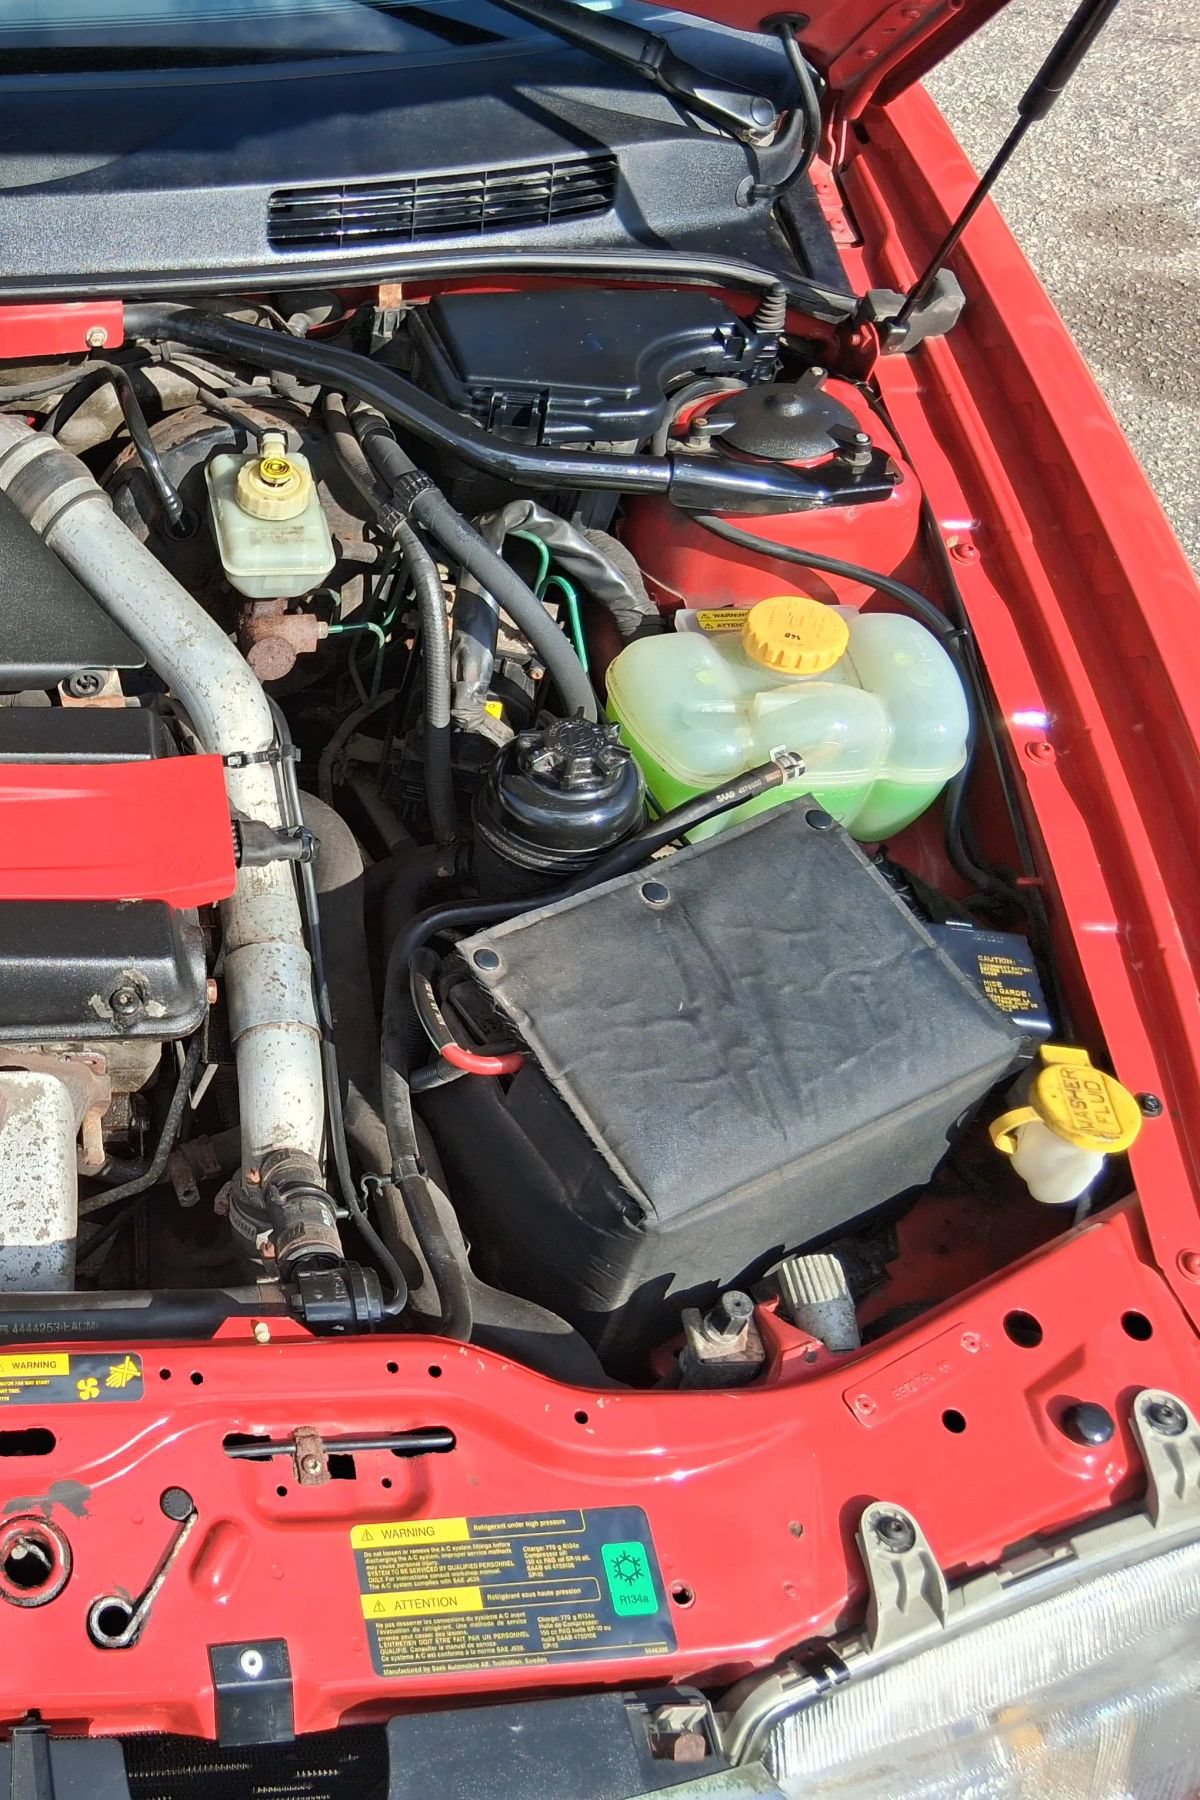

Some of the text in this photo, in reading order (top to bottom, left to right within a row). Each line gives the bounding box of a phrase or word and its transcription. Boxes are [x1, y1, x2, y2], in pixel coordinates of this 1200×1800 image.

[1060, 1068, 1095, 1129] WASHER
[1085, 1080, 1112, 1124] FLUID
[12, 1361, 57, 1369] WARNING
[381, 1526, 435, 1539] WARNING
[555, 1588, 581, 1596] pression
[619, 1593, 649, 1604] R134a
[393, 1596, 457, 1610] ATTENTION
